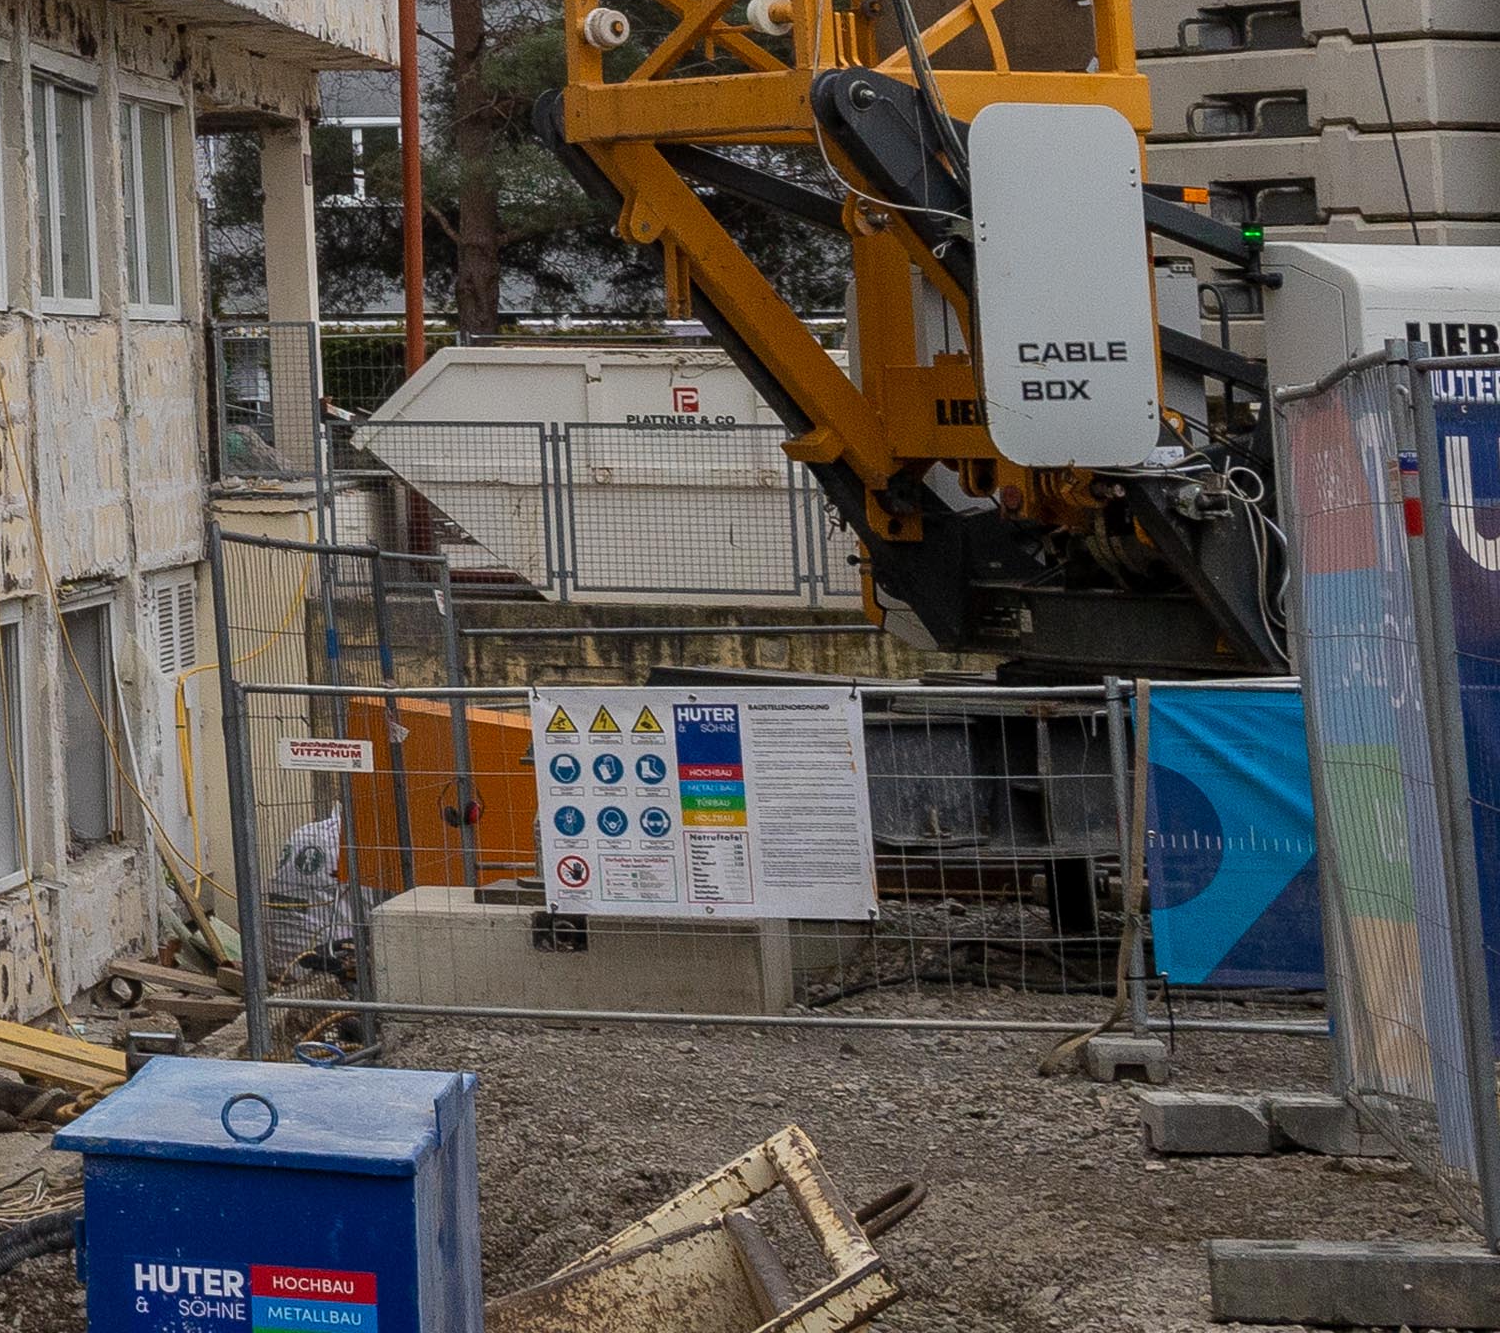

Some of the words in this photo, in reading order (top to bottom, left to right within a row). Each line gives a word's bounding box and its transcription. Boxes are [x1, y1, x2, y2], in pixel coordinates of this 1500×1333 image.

[1018, 341, 1128, 363] CABLE
[1022, 380, 1092, 401] BOX
[677, 706, 735, 722] HUTER
[700, 722, 736, 733] SÖHNE
[291, 748, 362, 758] VITZTHUM
[134, 1263, 246, 1299] HUTER
[272, 1275, 354, 1295] HOCHBAU
[135, 1296, 150, 1313] &
[178, 1295, 247, 1321] SÖHNE
[268, 1306, 362, 1326] METALLBAU
